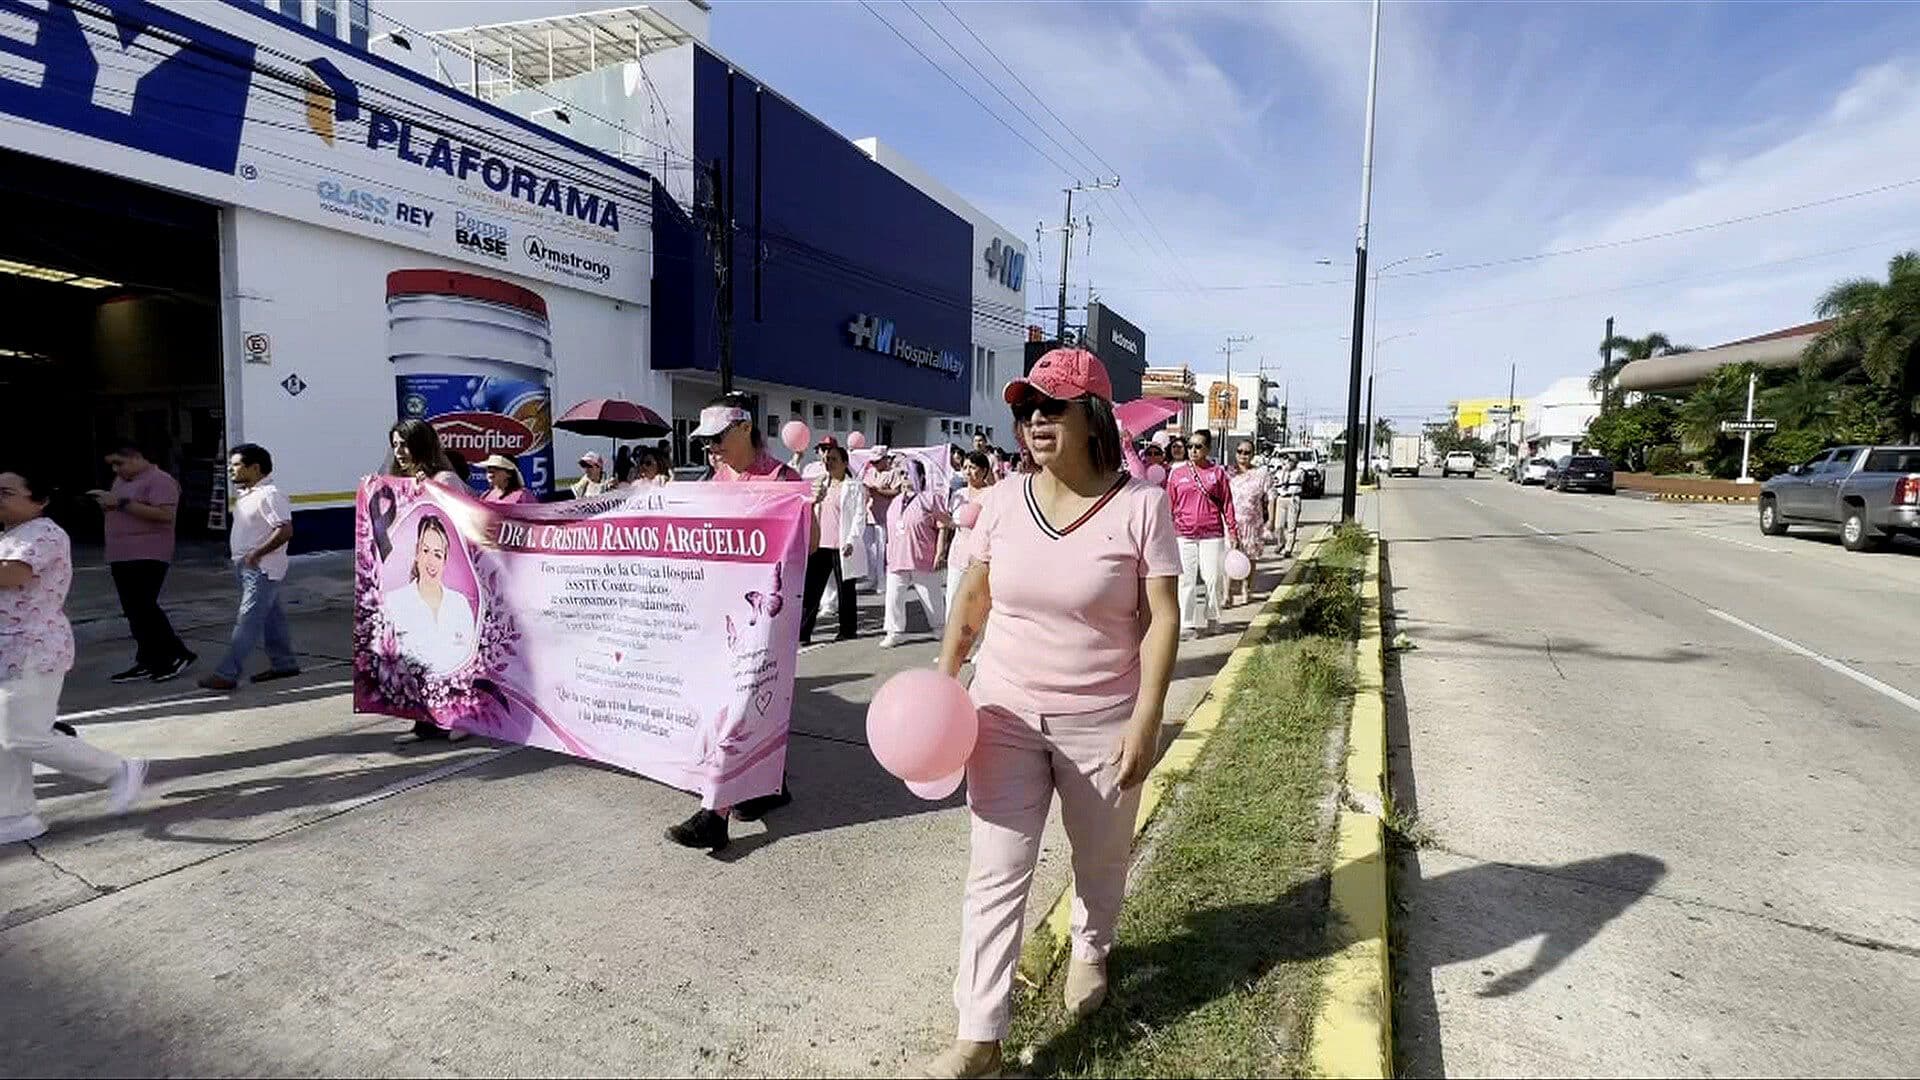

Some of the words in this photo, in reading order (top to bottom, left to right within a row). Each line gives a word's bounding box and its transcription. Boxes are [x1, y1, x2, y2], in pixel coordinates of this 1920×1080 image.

[367, 112, 620, 232] PLAFORAMA
[396, 202, 435, 228] REY
[455, 210, 508, 238] Perma
[455, 229, 509, 256] BASE
[524, 235, 611, 281] Armstrong
[437, 429, 525, 454] ermofiber
[531, 457, 549, 488] 5
[498, 521, 536, 548] DRA.
[540, 525, 598, 550] CRISTINA
[601, 523, 659, 551] RAMOS
[664, 522, 767, 556] ARGÜELLO
[604, 563, 617, 576] de
[619, 563, 629, 576] la
[662, 565, 705, 582] Hospital
